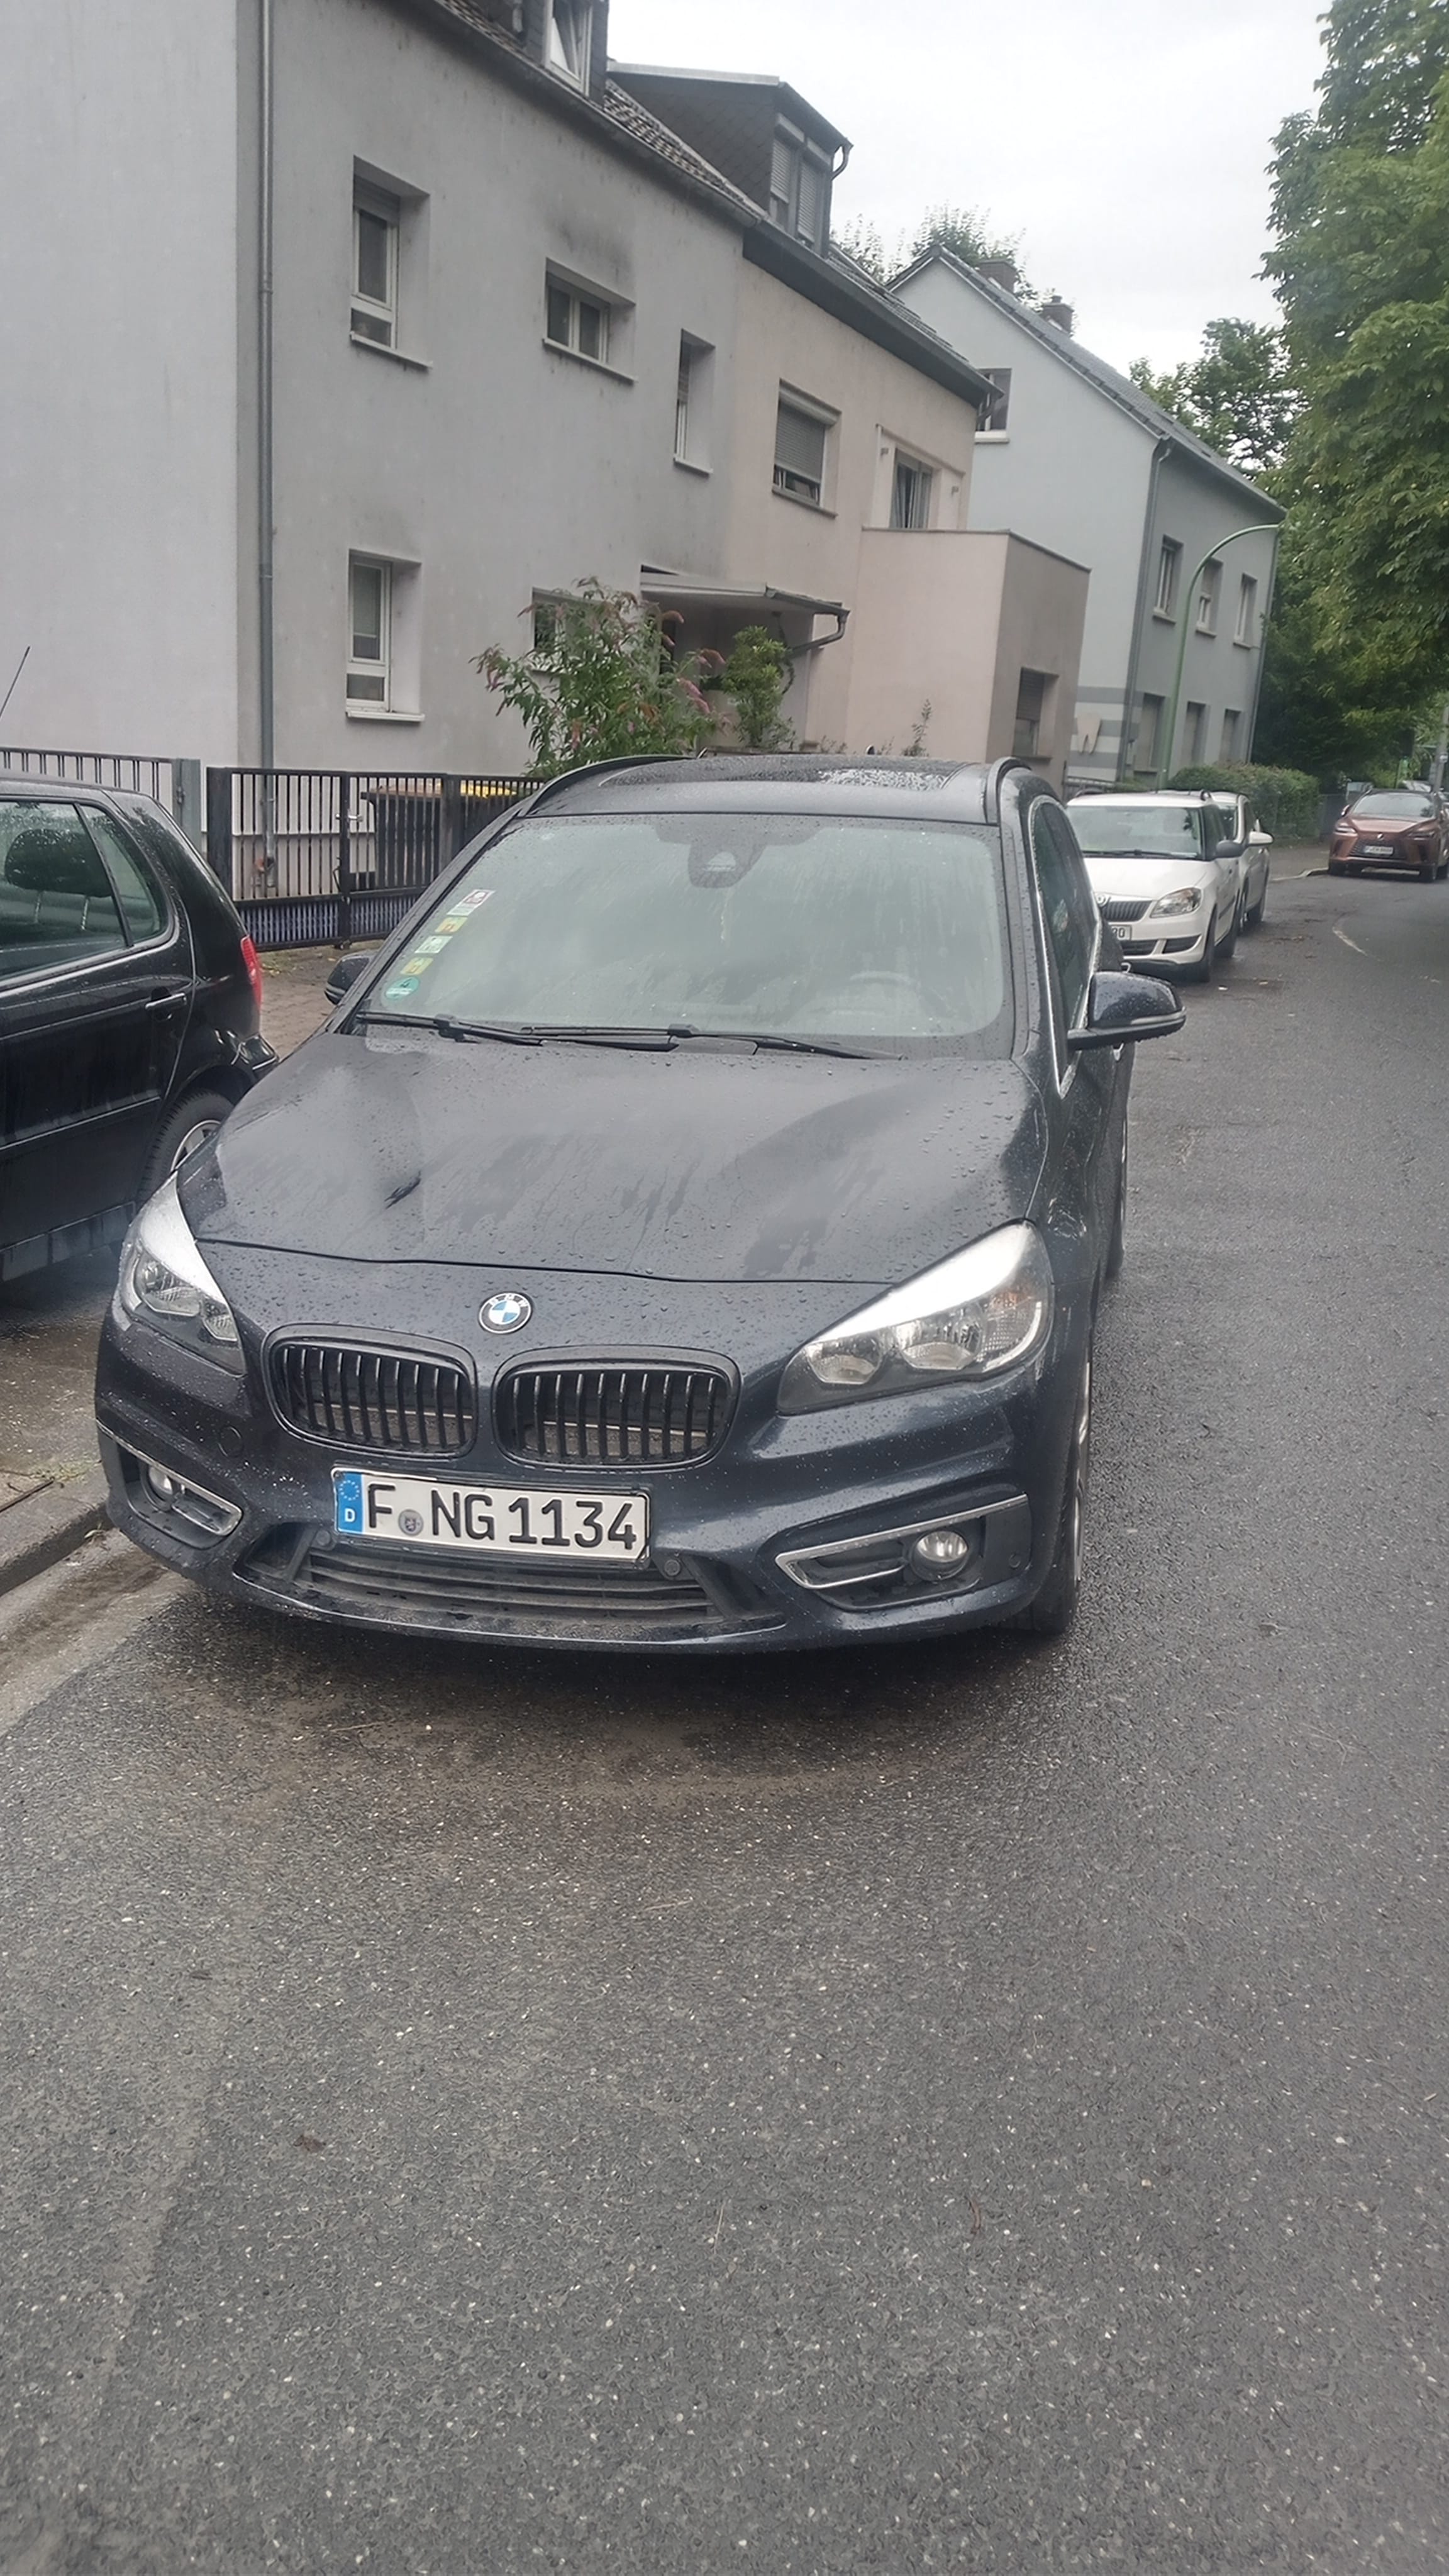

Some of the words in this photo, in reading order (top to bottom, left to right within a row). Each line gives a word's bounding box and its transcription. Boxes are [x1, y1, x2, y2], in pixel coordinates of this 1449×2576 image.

[344, 1507, 355, 1522] D
[368, 1483, 396, 1528] F
[431, 1489, 495, 1541] NG
[508, 1497, 636, 1550] 1134
